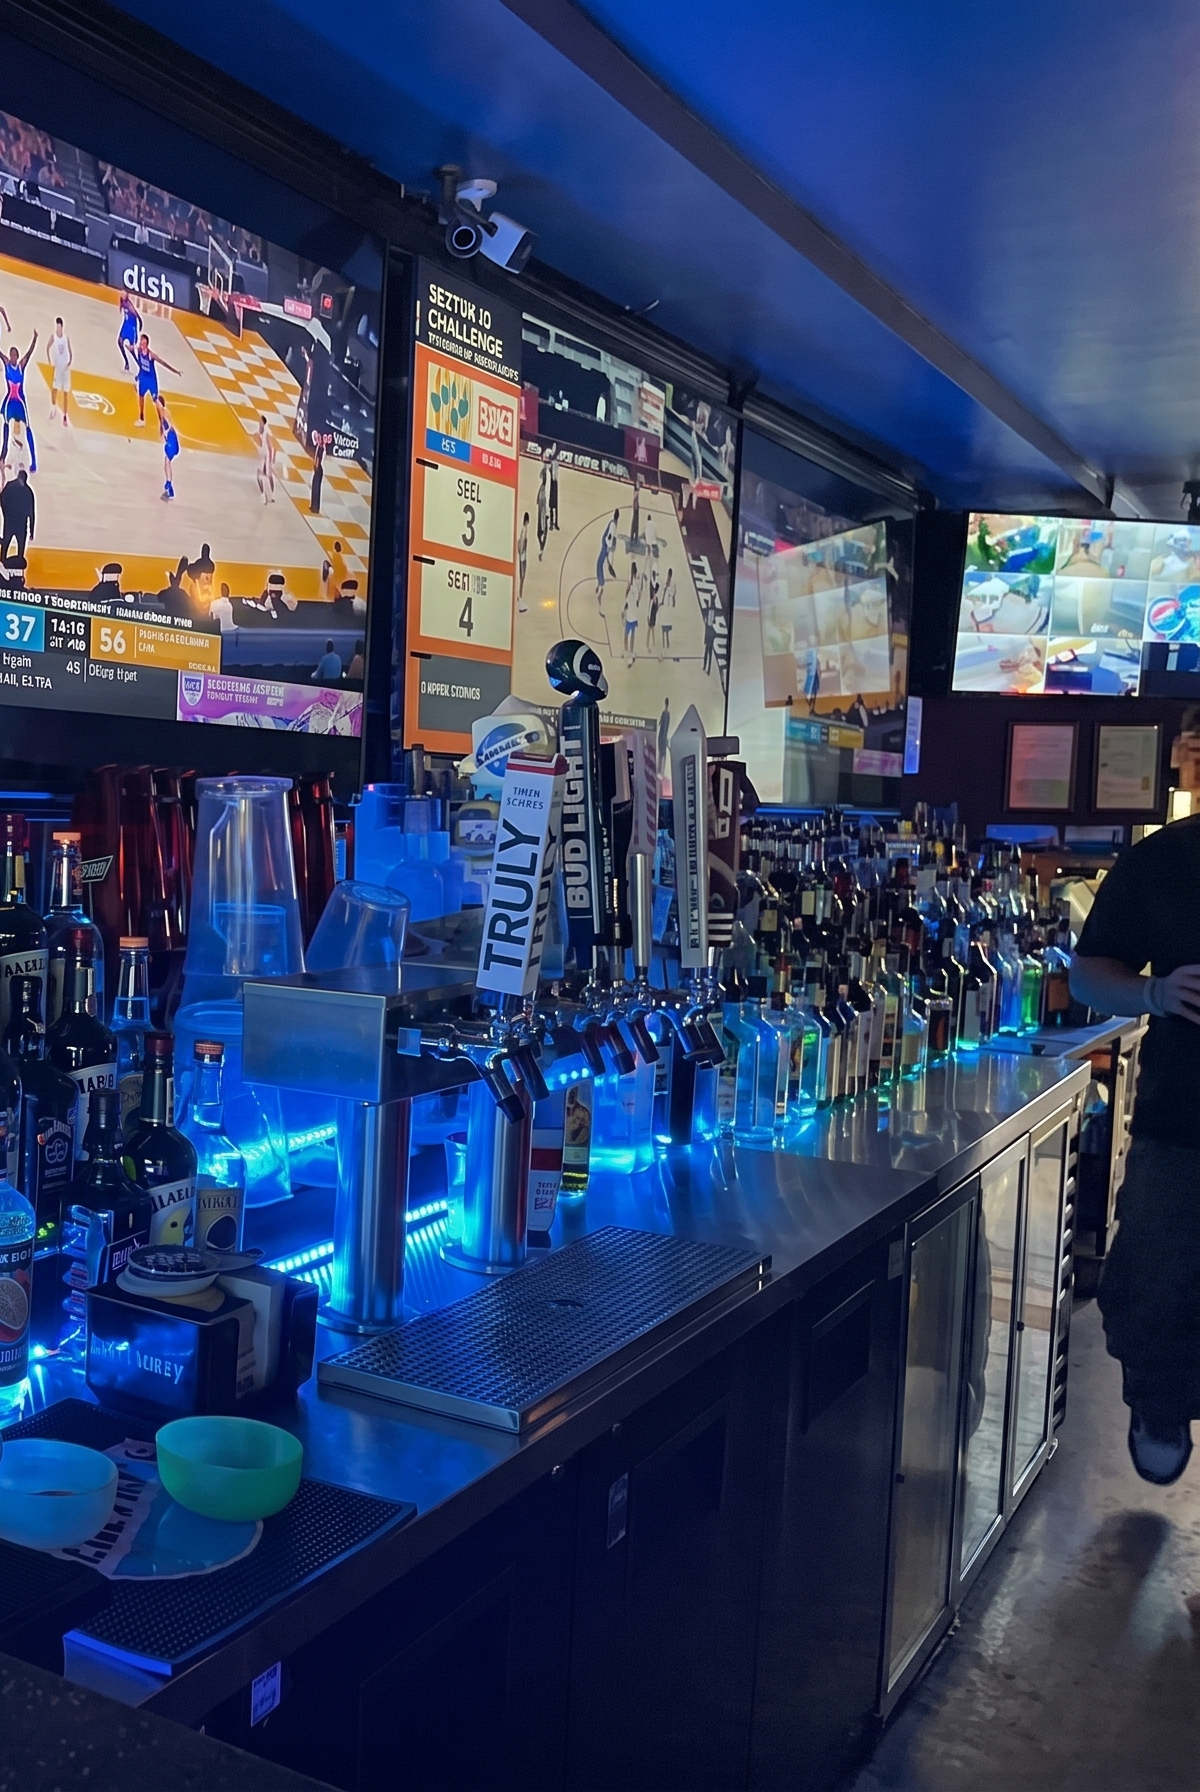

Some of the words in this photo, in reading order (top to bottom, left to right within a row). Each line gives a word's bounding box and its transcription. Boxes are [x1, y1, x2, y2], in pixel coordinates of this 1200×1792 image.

[124, 264, 174, 304] dish
[428, 308, 503, 359] CHALLENGE
[462, 504, 476, 547] 3
[5, 613, 36, 643] 37
[459, 597, 473, 637] 4
[100, 627, 126, 655] 56
[560, 735, 586, 833] LIGHT
[483, 818, 541, 972] TRULY
[566, 838, 591, 909] BUD
